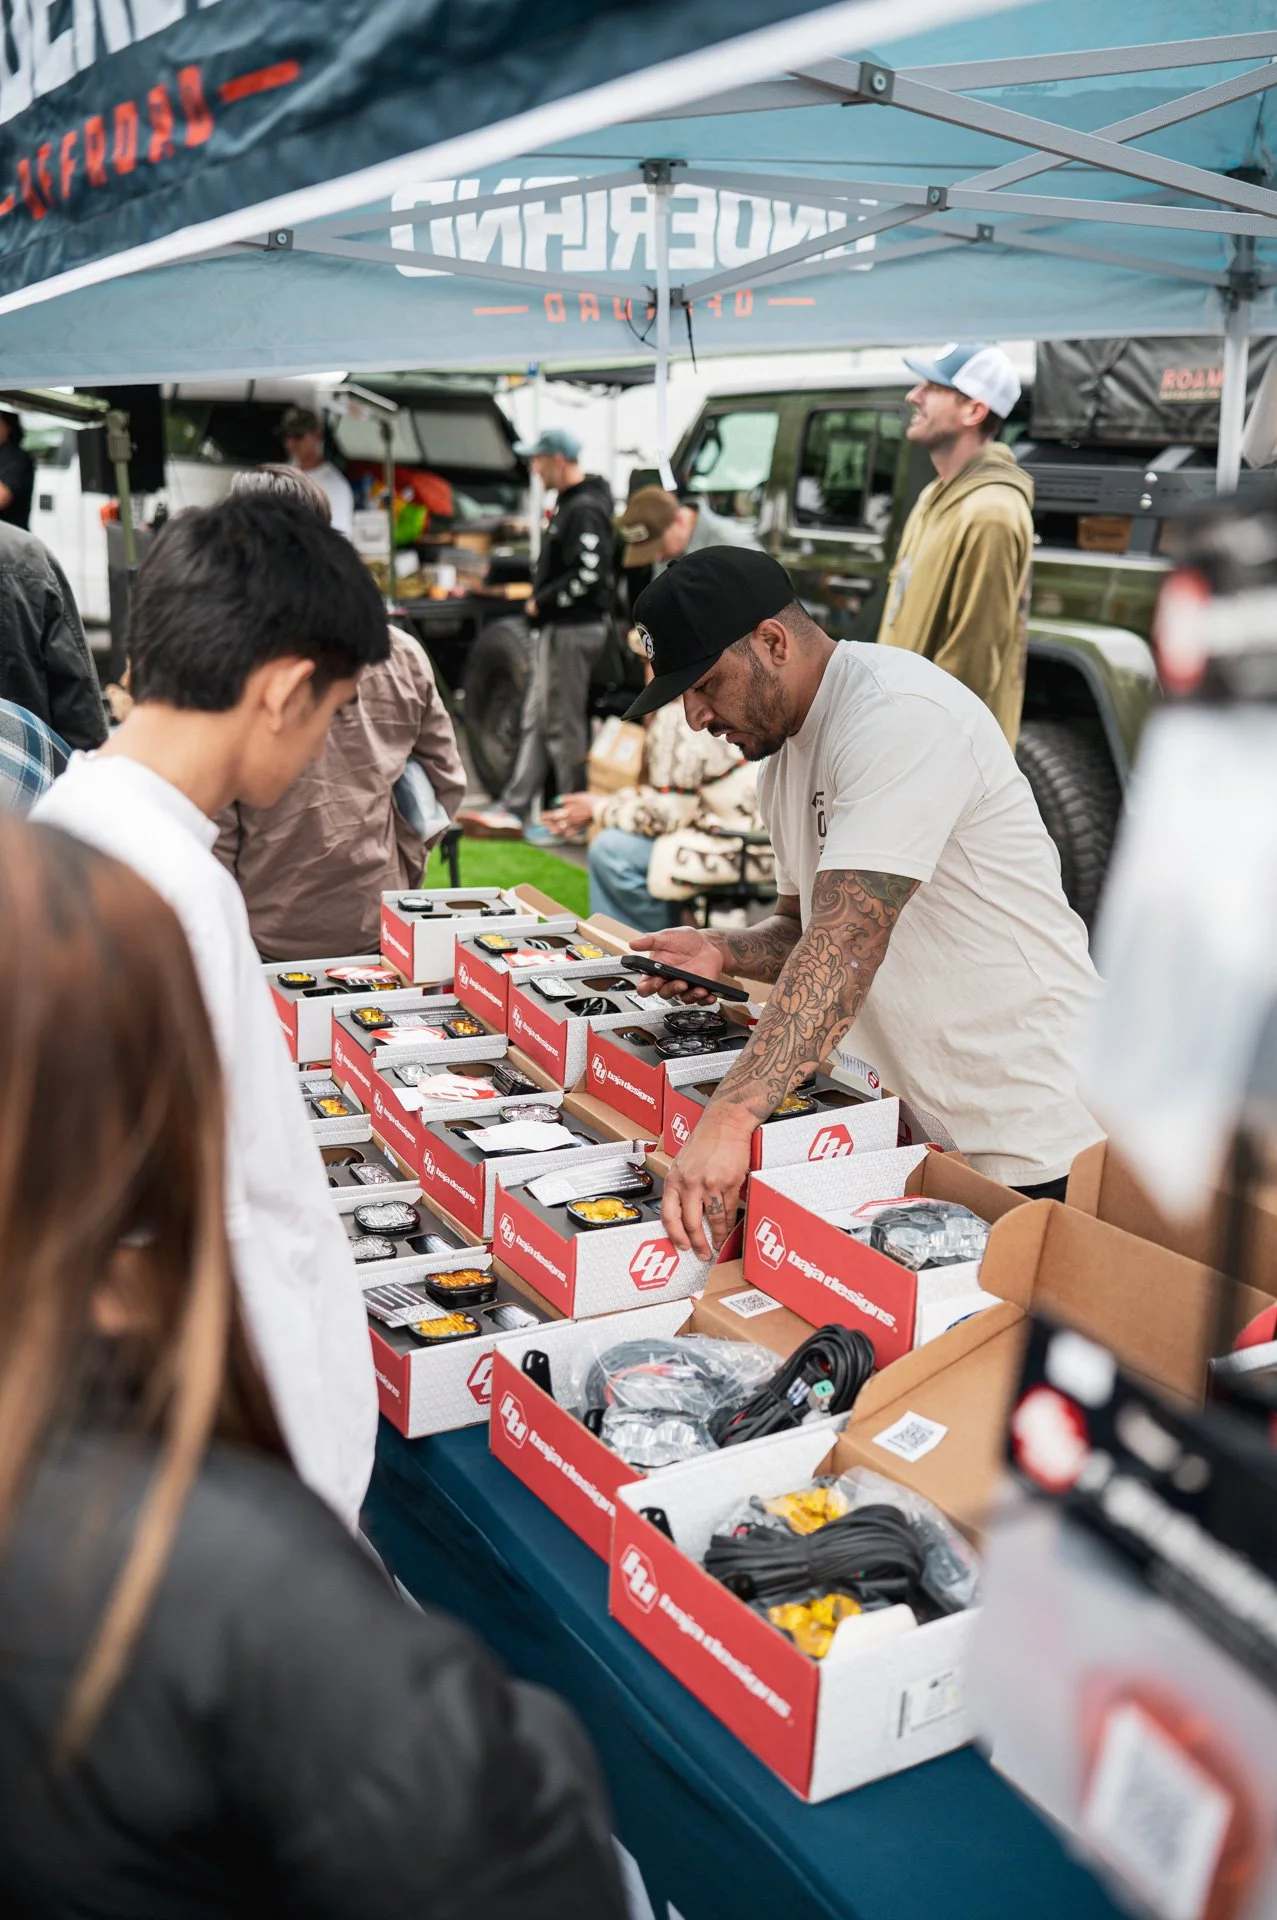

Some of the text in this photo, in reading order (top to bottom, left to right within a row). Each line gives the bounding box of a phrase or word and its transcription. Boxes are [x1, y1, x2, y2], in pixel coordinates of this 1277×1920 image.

[624, 1080, 655, 1105] designs
[787, 1250, 825, 1283] baja
[823, 1276, 896, 1327] designs
[561, 1462, 616, 1517] design
